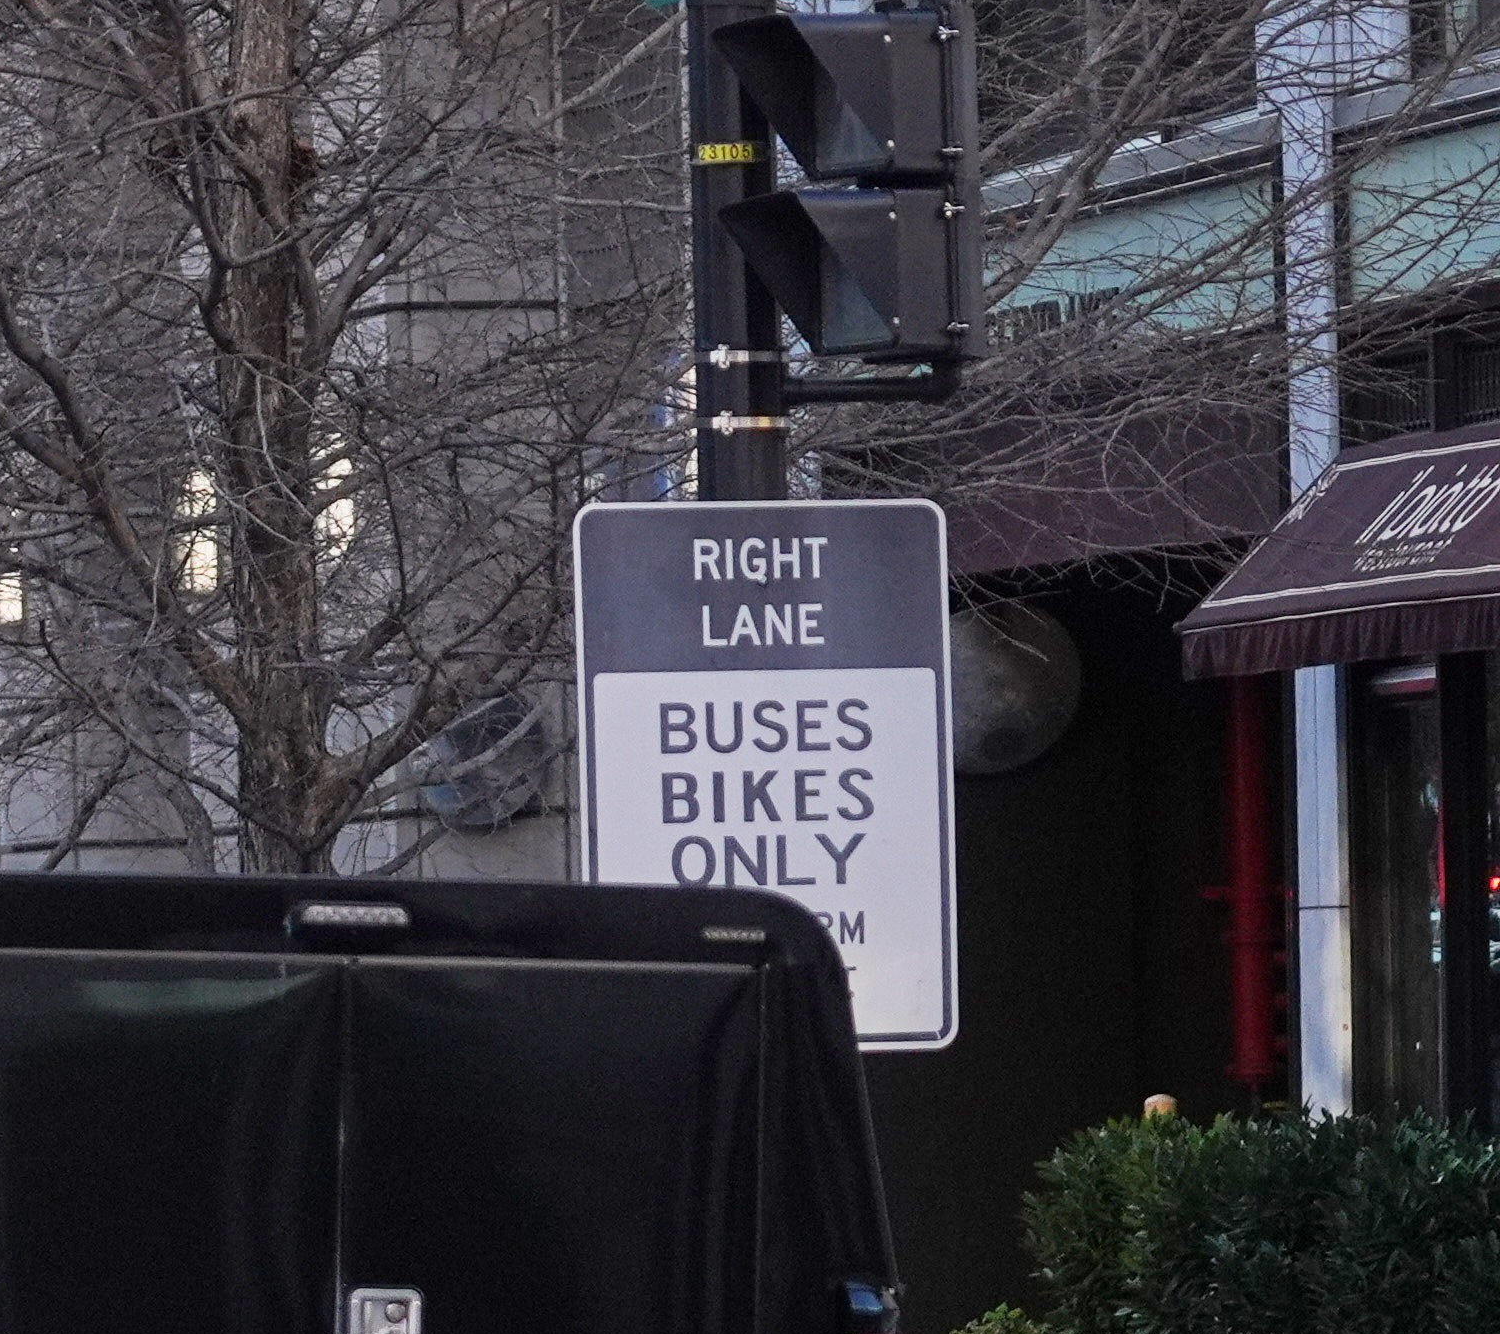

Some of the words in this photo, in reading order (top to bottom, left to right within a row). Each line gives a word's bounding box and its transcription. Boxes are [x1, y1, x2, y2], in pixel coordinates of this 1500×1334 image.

[700, 144, 750, 160] 23105
[693, 537, 828, 581] RIGHT
[701, 603, 825, 647] LANE
[659, 700, 873, 754] BUSES
[661, 769, 875, 824] BIKES
[671, 833, 867, 887] ONLY
